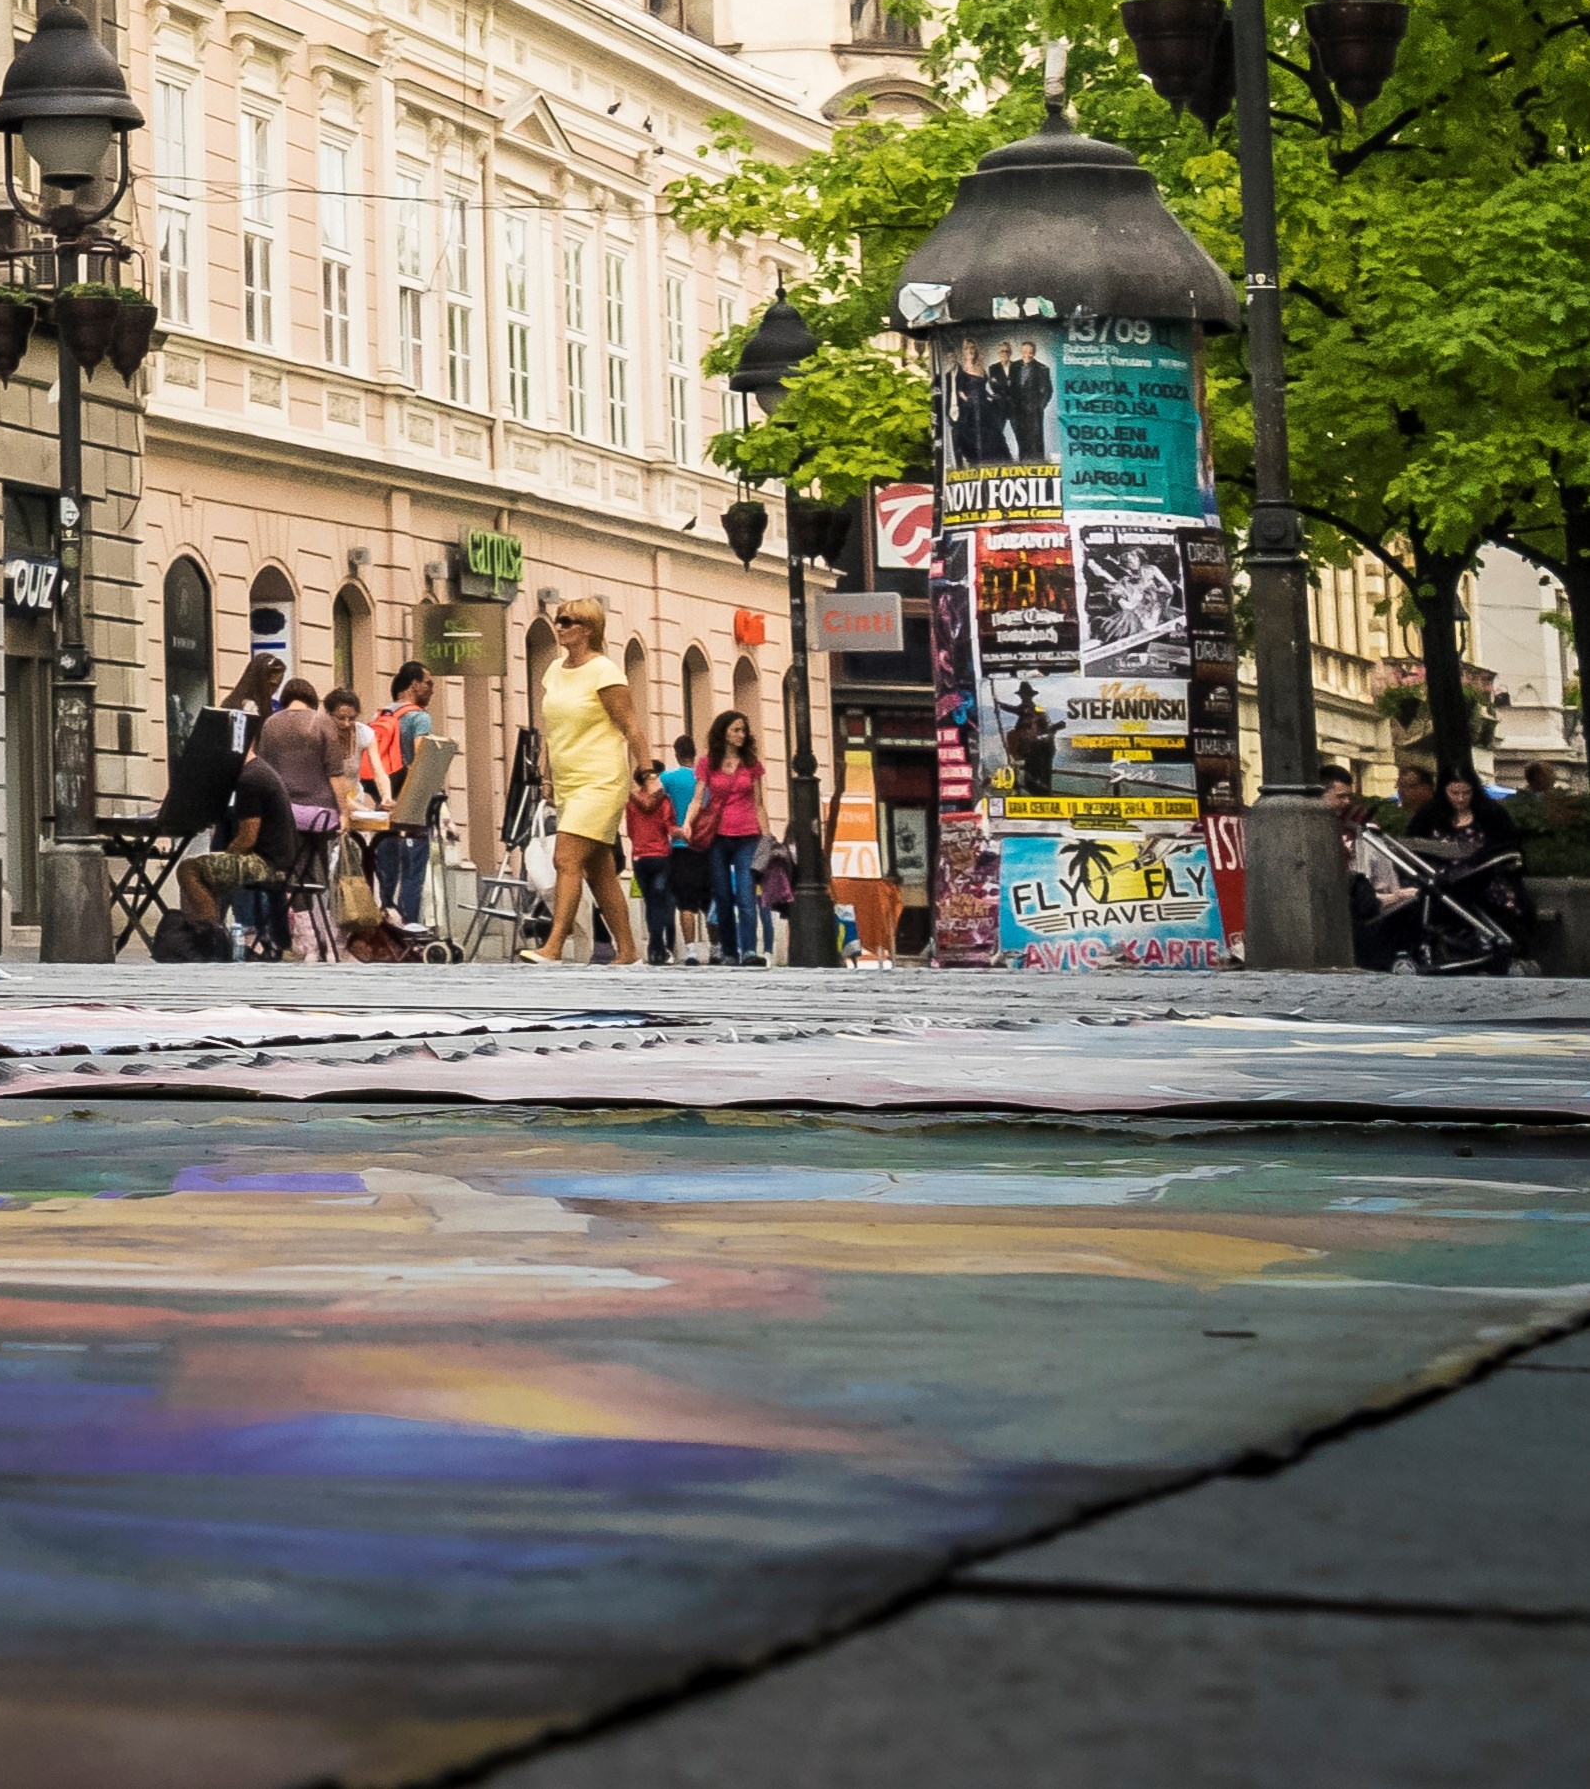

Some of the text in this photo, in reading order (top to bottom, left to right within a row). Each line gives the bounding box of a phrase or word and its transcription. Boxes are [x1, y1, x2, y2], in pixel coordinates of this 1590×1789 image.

[1067, 424, 1147, 443] OBOJENI
[1069, 443, 1160, 460] PROGRAM
[945, 477, 1062, 513] NOVI FOSILI
[823, 609, 893, 634] Cinti
[1066, 697, 1187, 721] STEFANOVSKI
[1012, 866, 1207, 915] FLY FLY
[1064, 903, 1167, 929] TRAVEL
[1023, 938, 1219, 970] AVIO KARTE
